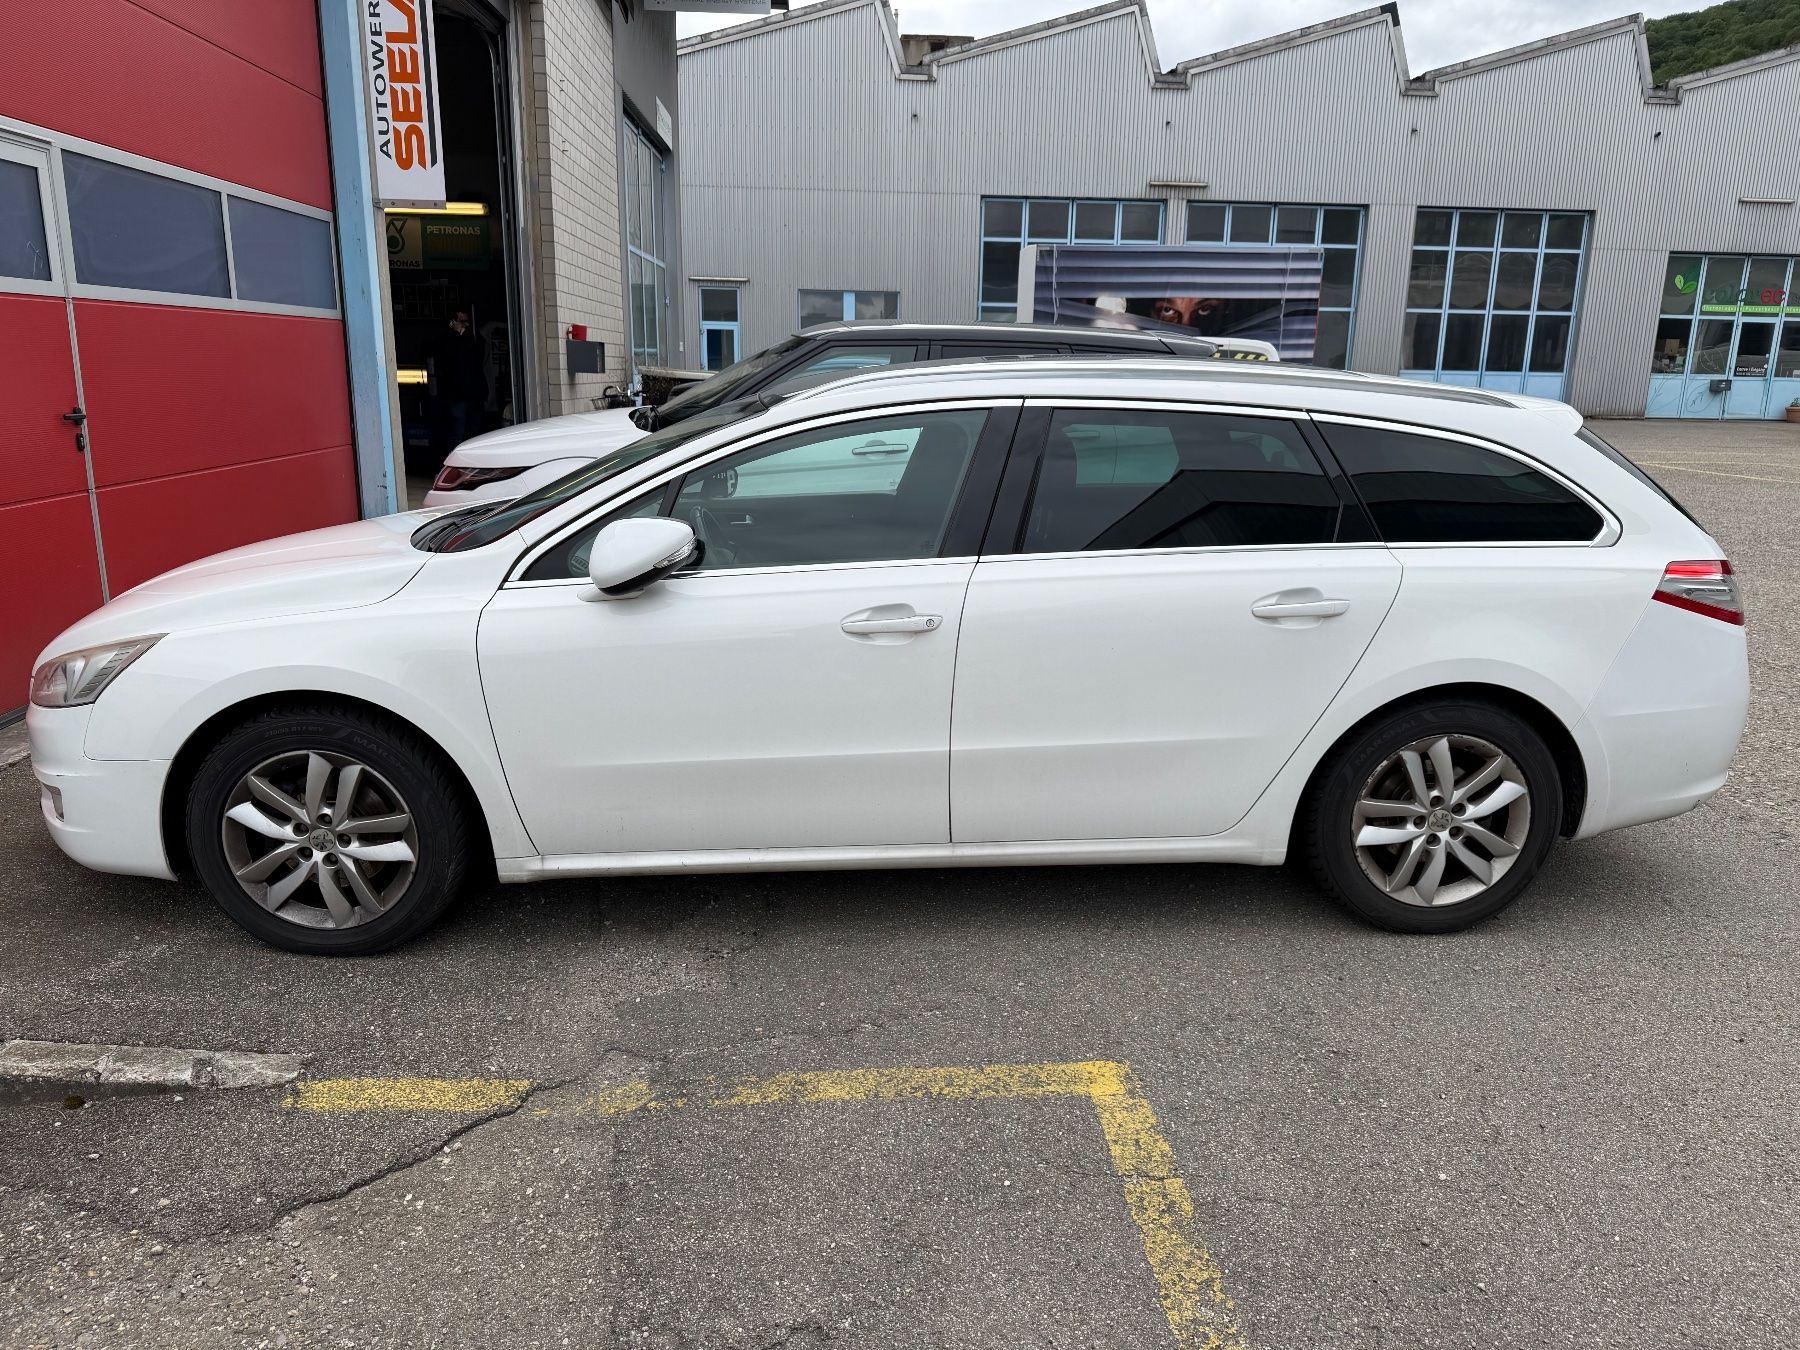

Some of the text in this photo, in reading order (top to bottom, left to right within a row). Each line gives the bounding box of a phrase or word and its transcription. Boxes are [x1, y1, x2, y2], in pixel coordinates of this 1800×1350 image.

[368, 0, 392, 160] AUTOWER
[426, 225, 481, 235] PETRONAS
[389, 259, 420, 268] RONAS
